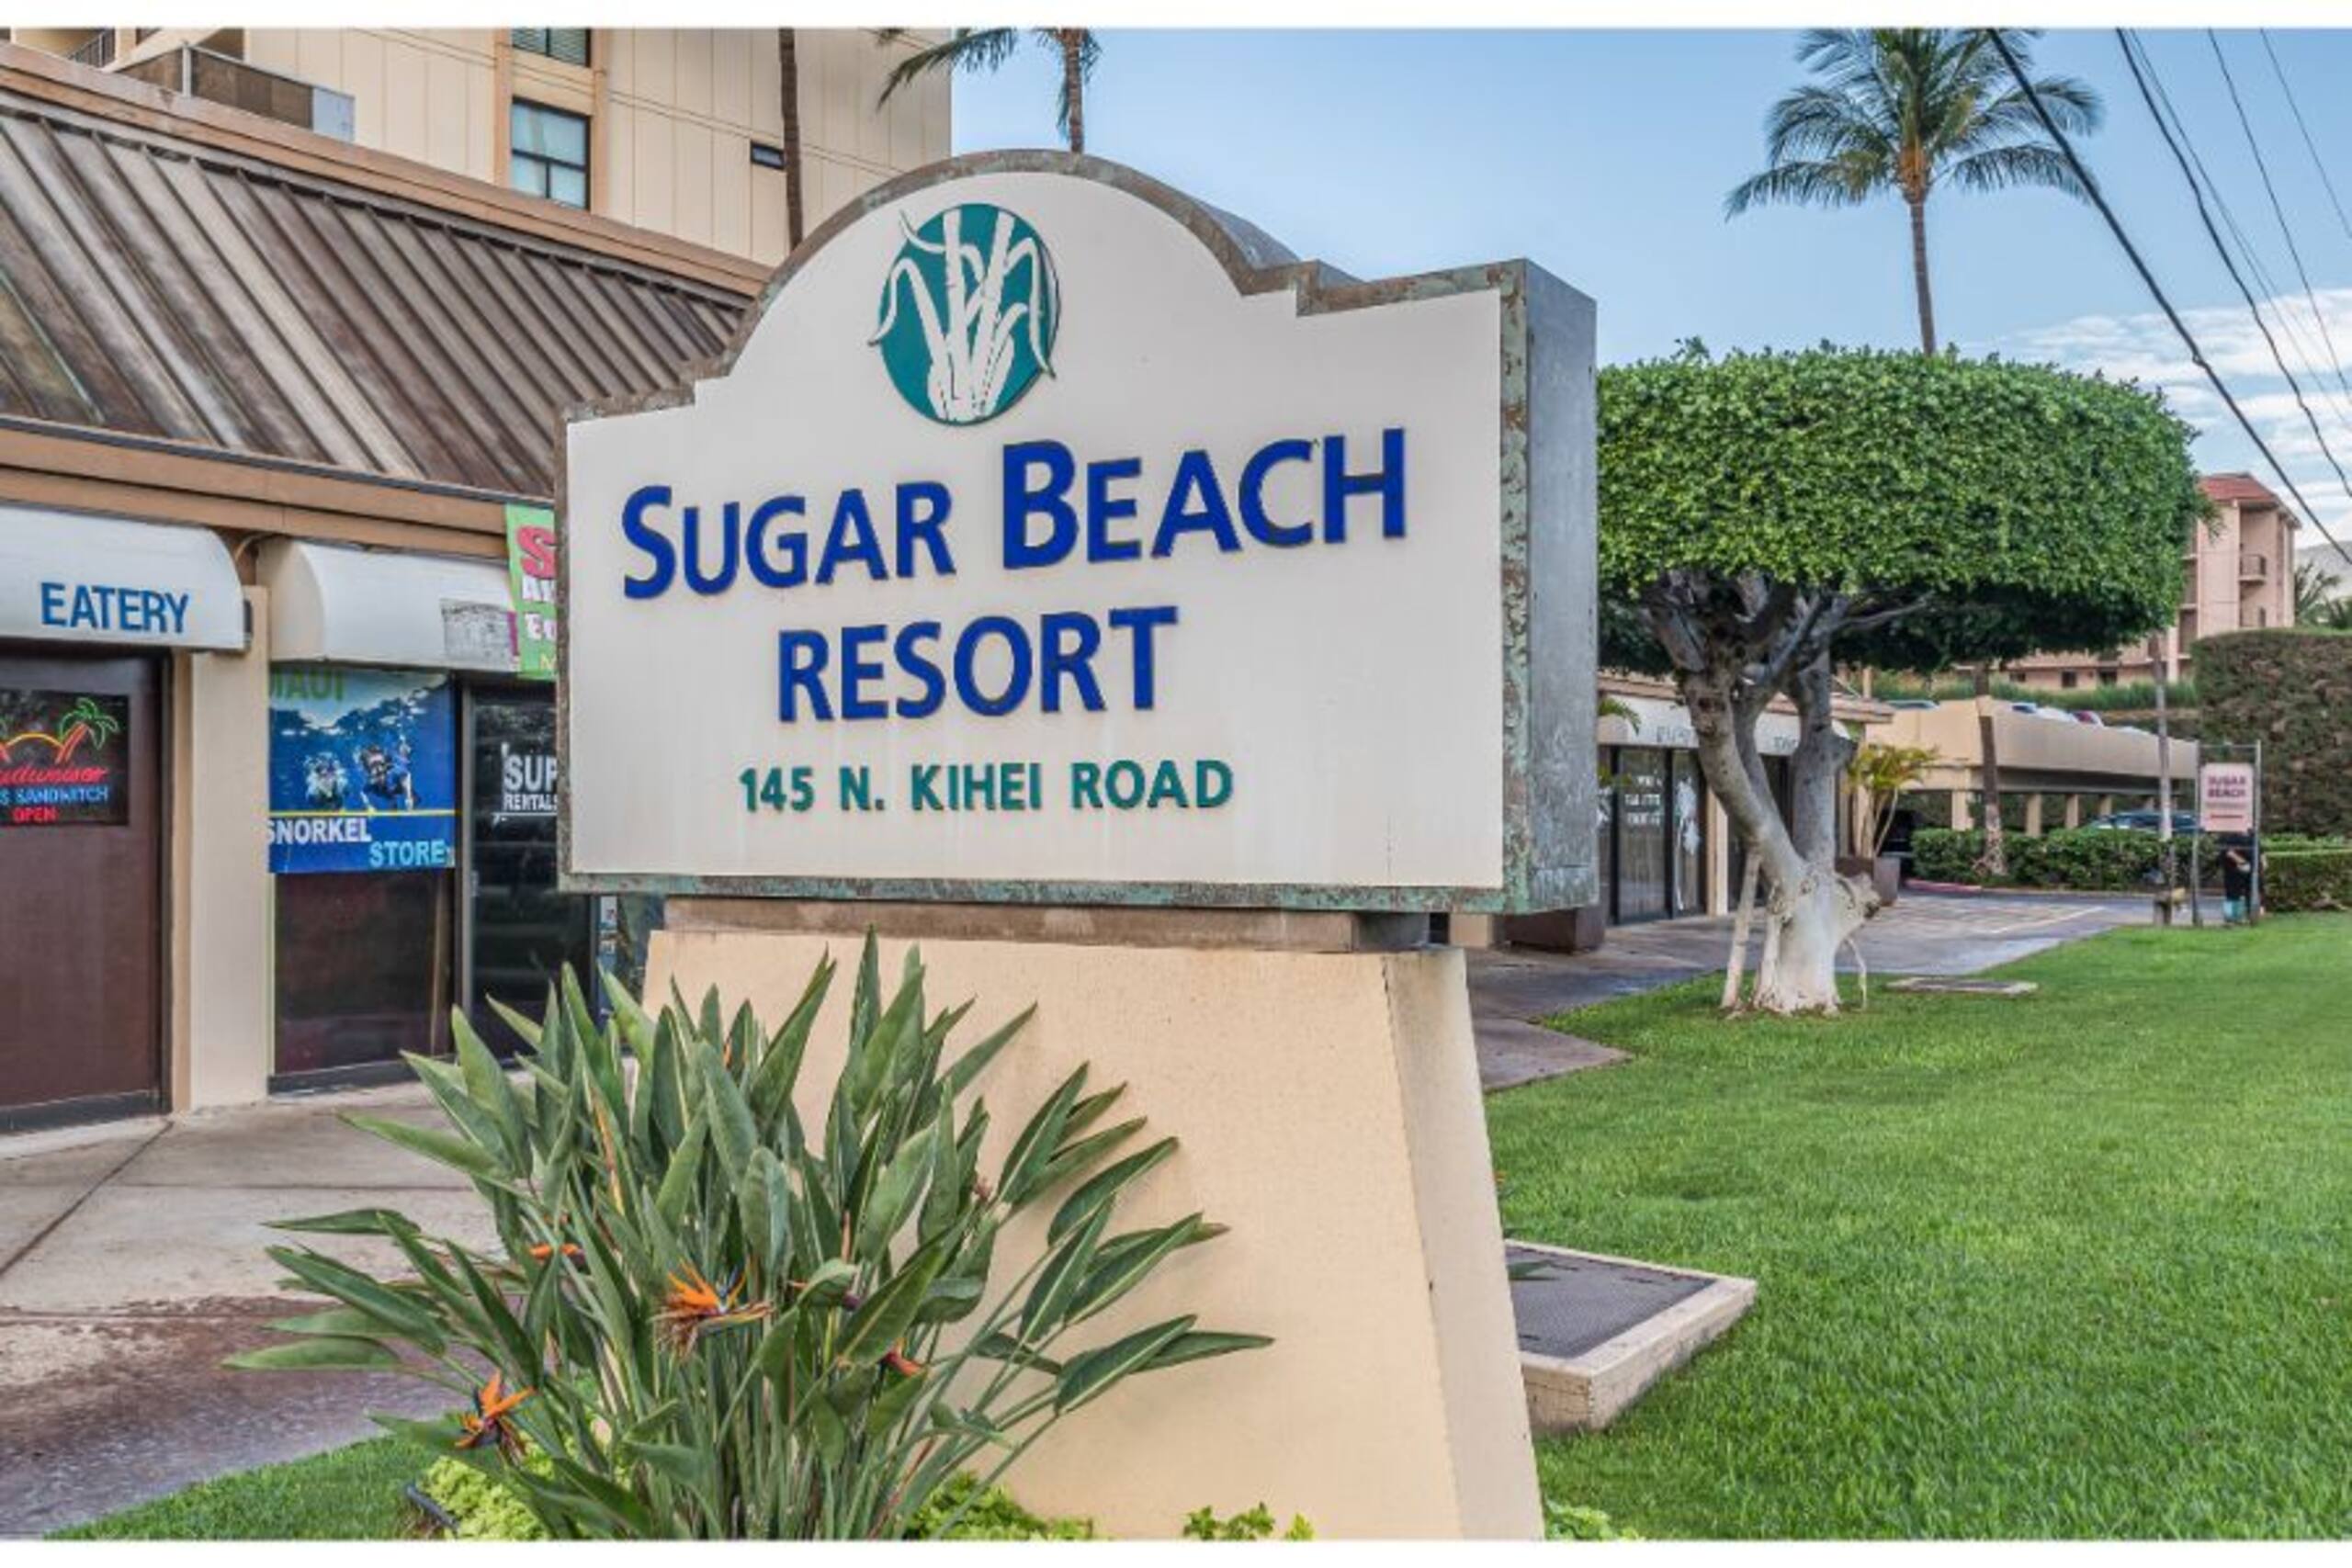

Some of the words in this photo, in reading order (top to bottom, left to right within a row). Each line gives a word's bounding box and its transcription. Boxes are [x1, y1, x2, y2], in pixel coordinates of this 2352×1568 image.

[40, 581, 189, 633] EATERY
[777, 604, 1179, 723] RESORT
[740, 767, 815, 811] 145
[839, 767, 884, 810] N.
[910, 761, 1042, 810] KIHEI
[1069, 759, 1233, 809] ROAD
[13, 806, 58, 823] OPEN
